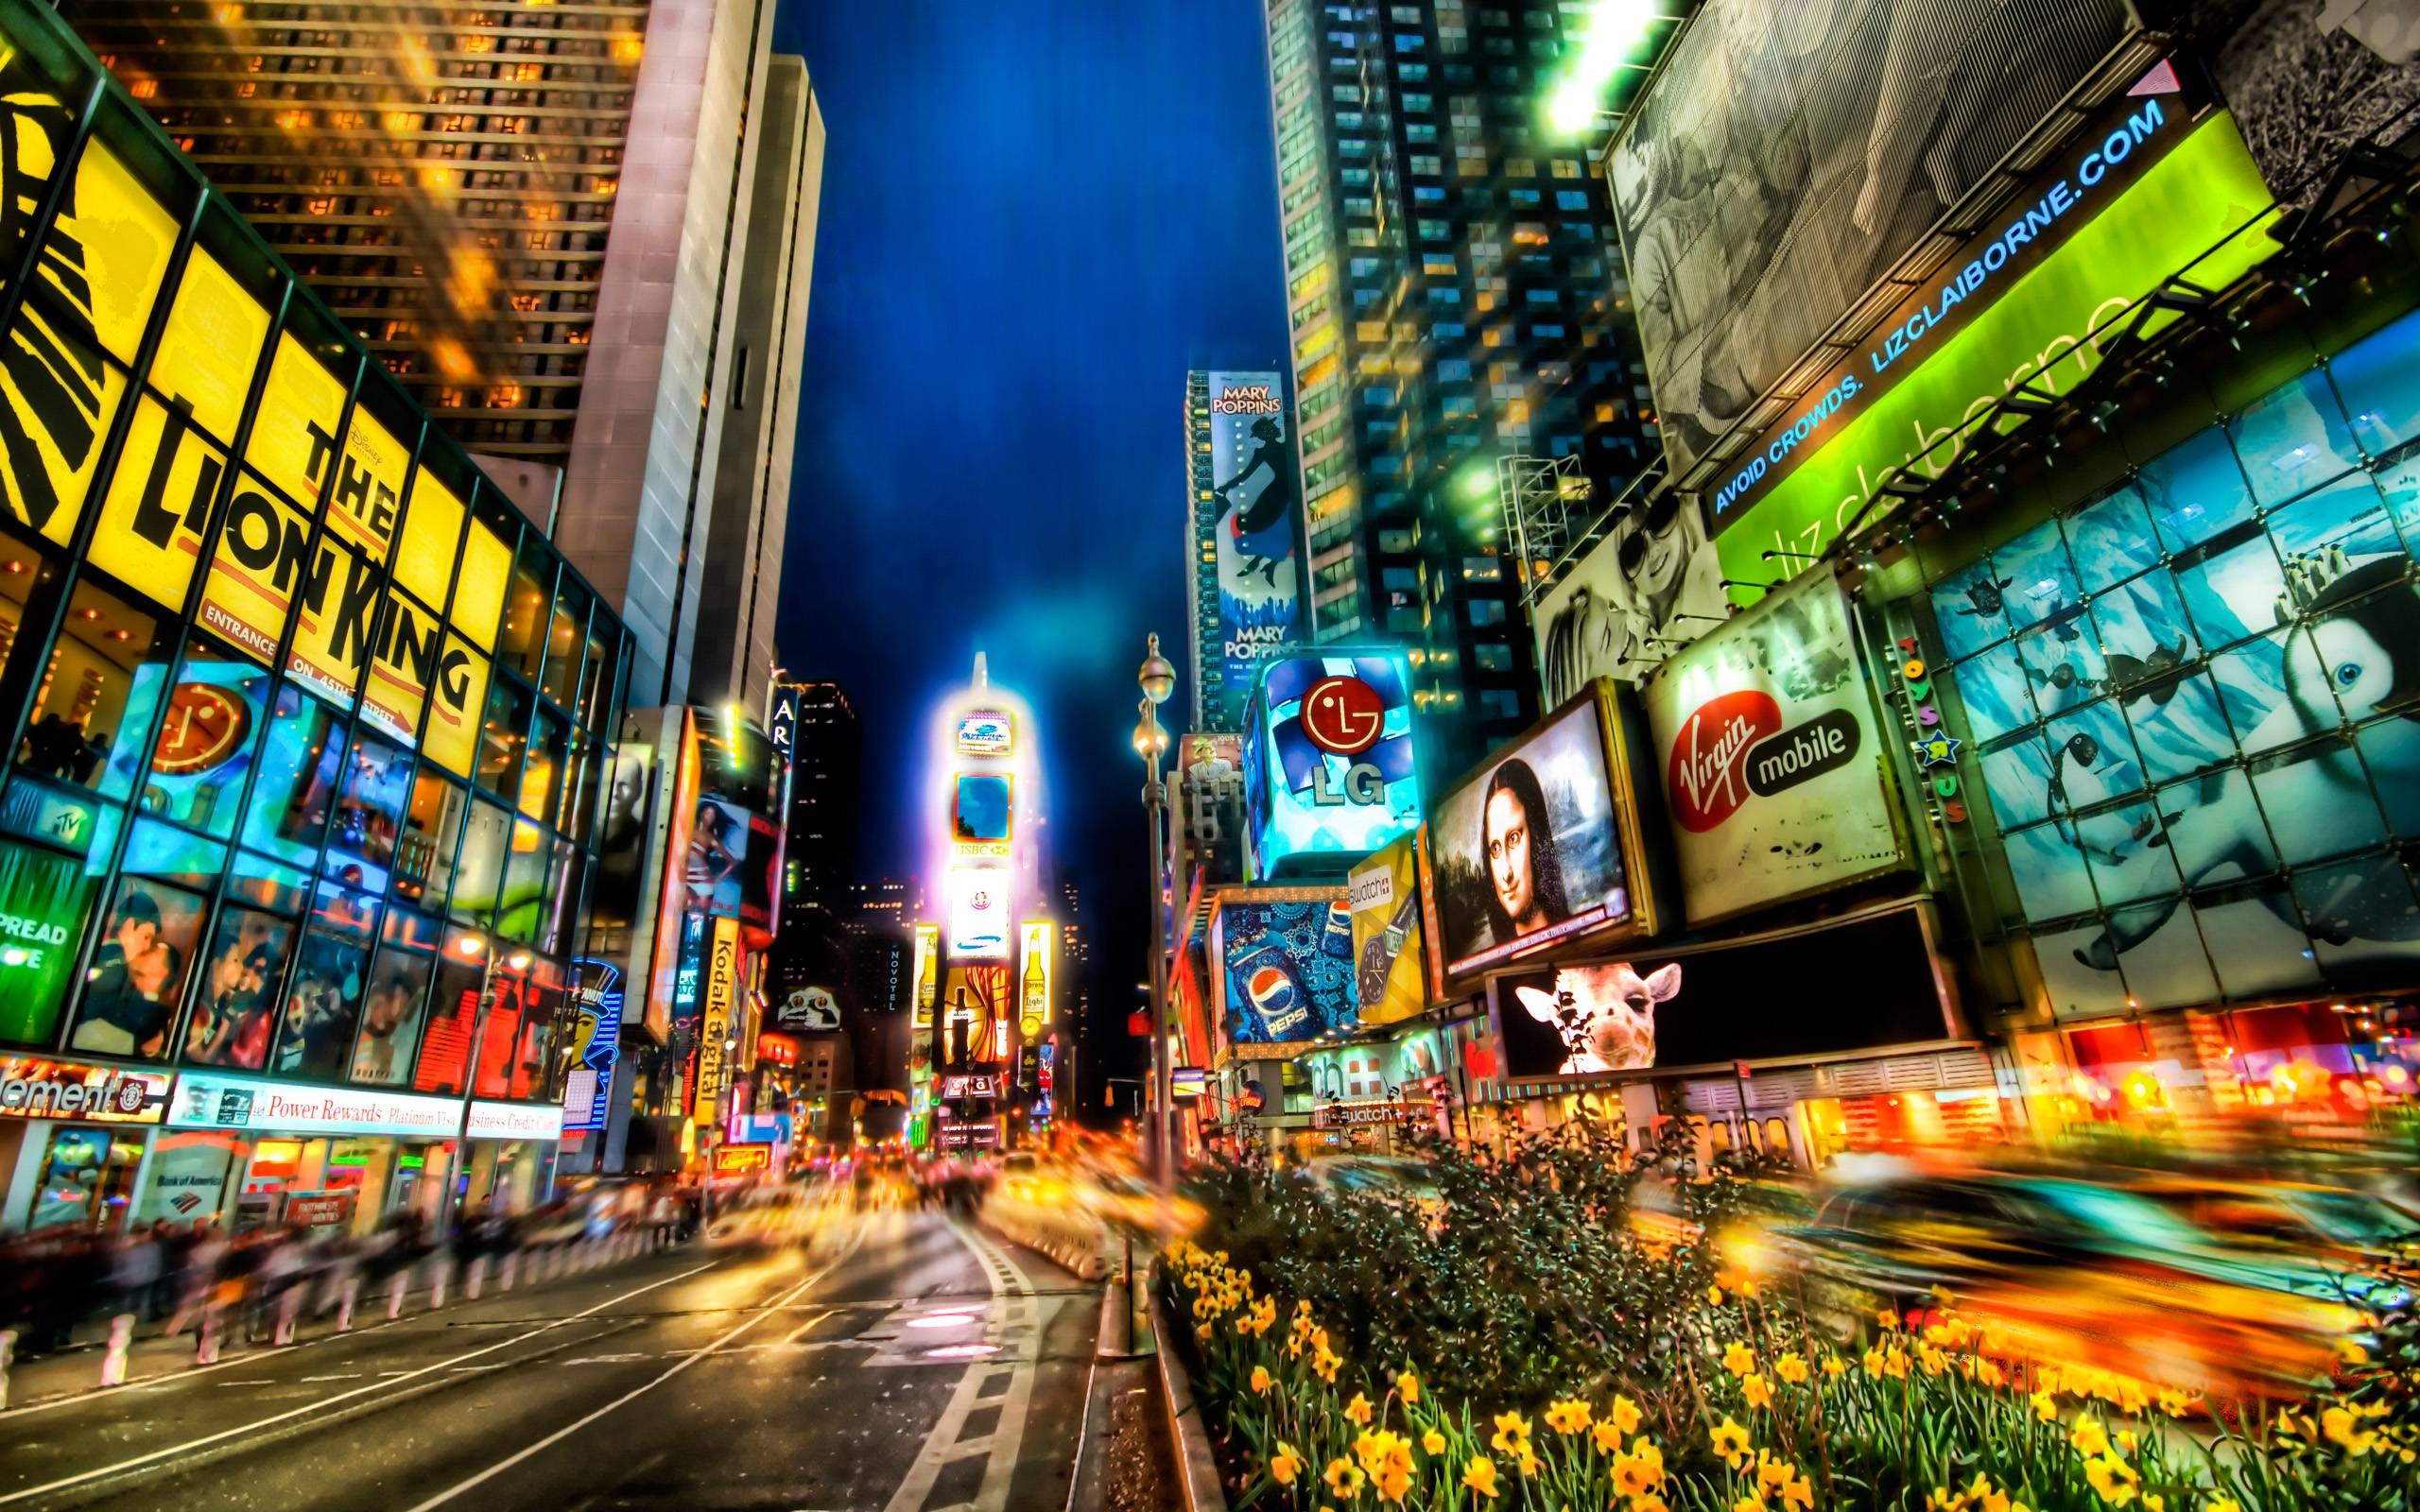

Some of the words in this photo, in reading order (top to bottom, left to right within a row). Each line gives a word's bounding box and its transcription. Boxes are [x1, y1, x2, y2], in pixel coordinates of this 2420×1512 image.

[1716, 456, 1767, 515] AVOID
[1769, 374, 1865, 464] CROWDS.
[1871, 98, 2164, 373] LIZCLAIBORNE.COM
[1212, 398, 1282, 414] POPPINS
[1223, 386, 1270, 400] MARY
[131, 392, 335, 617] LION
[304, 419, 396, 542] THE
[327, 541, 471, 713] KING
[1236, 625, 1287, 643] MARY
[205, 605, 276, 657] ENTRANCE
[293, 658, 314, 679] ON
[320, 674, 350, 697] 45TH
[362, 700, 396, 725] STREET
[1313, 763, 1386, 807] LG
[1680, 714, 1756, 816] Virgin
[1759, 725, 1847, 785] mobile
[1350, 877, 1382, 904] swatch
[1325, 923, 1351, 936] PEPSI
[711, 939, 732, 1013] Kodak
[890, 952, 899, 1011] NOVOTEL
[1267, 1006, 1308, 1038] PEPSI
[269, 1094, 319, 1118] Power
[322, 1098, 382, 1122] Rewards
[389, 1108, 434, 1125] Platinum
[467, 1112, 506, 1127] usiness
